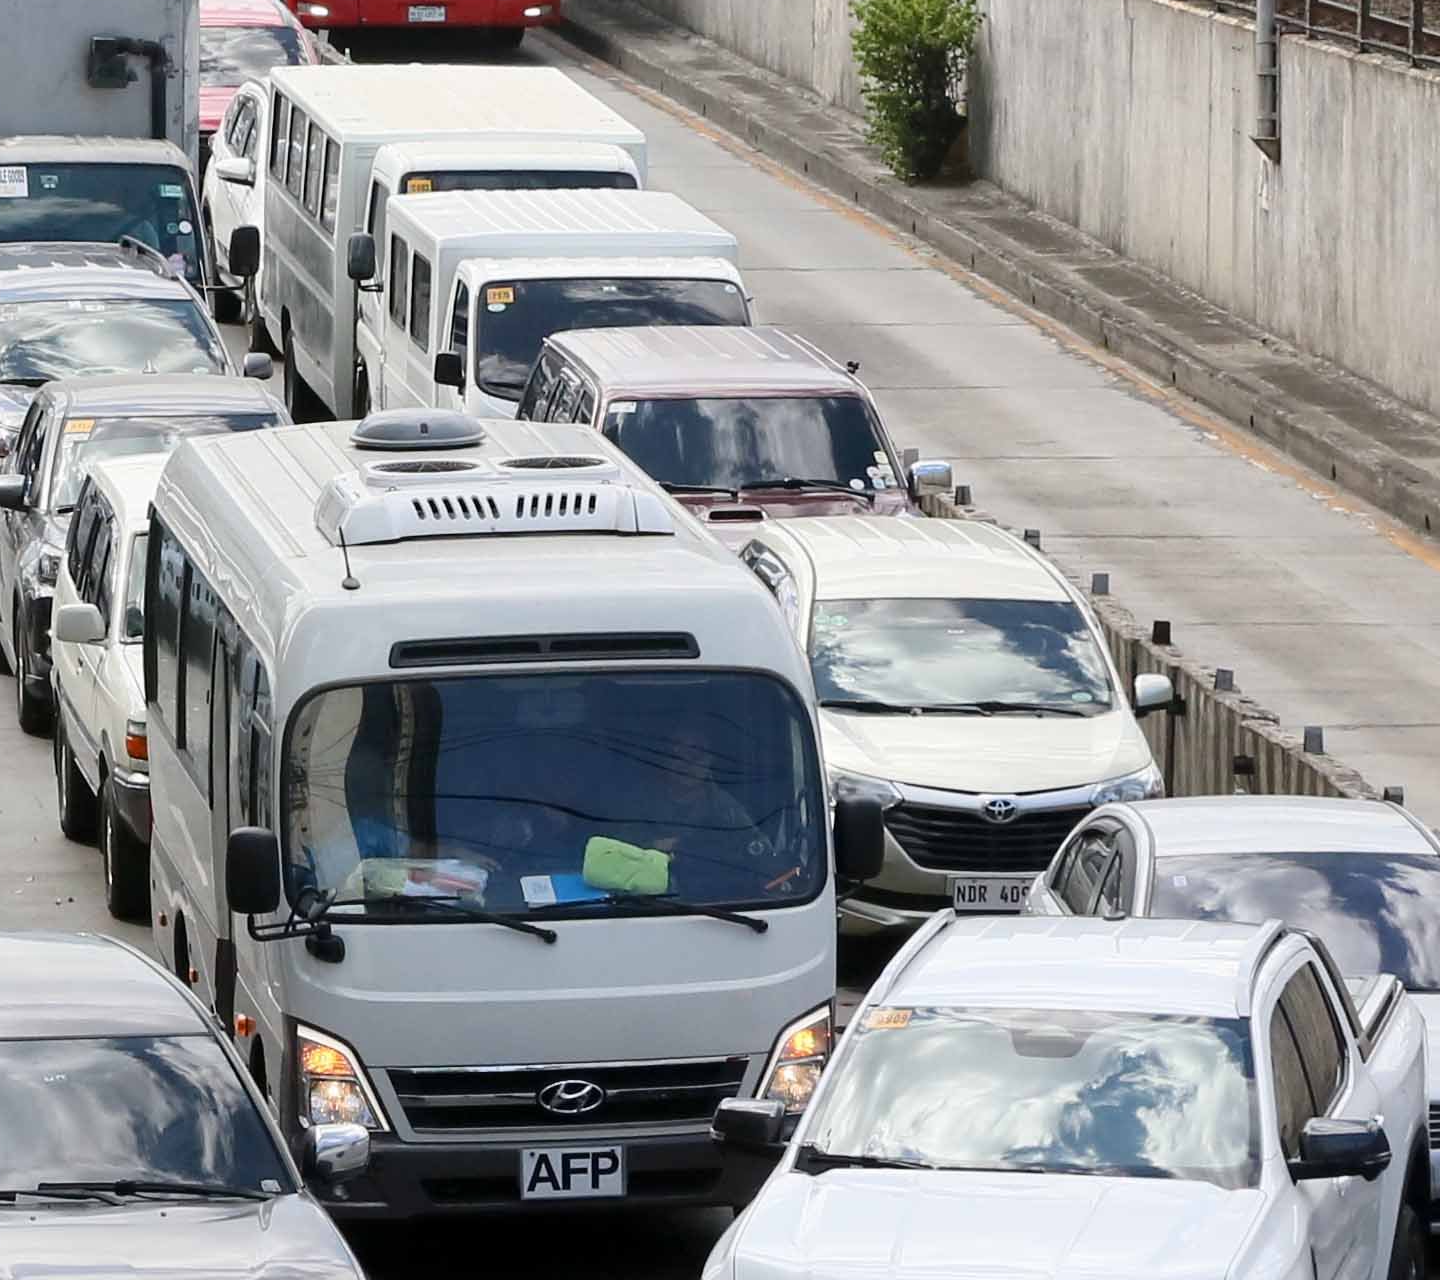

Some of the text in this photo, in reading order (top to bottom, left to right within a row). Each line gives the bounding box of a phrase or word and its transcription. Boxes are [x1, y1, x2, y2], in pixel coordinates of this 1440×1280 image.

[957, 885, 1029, 903] NDR 40
[527, 1152, 619, 1192] AFP
